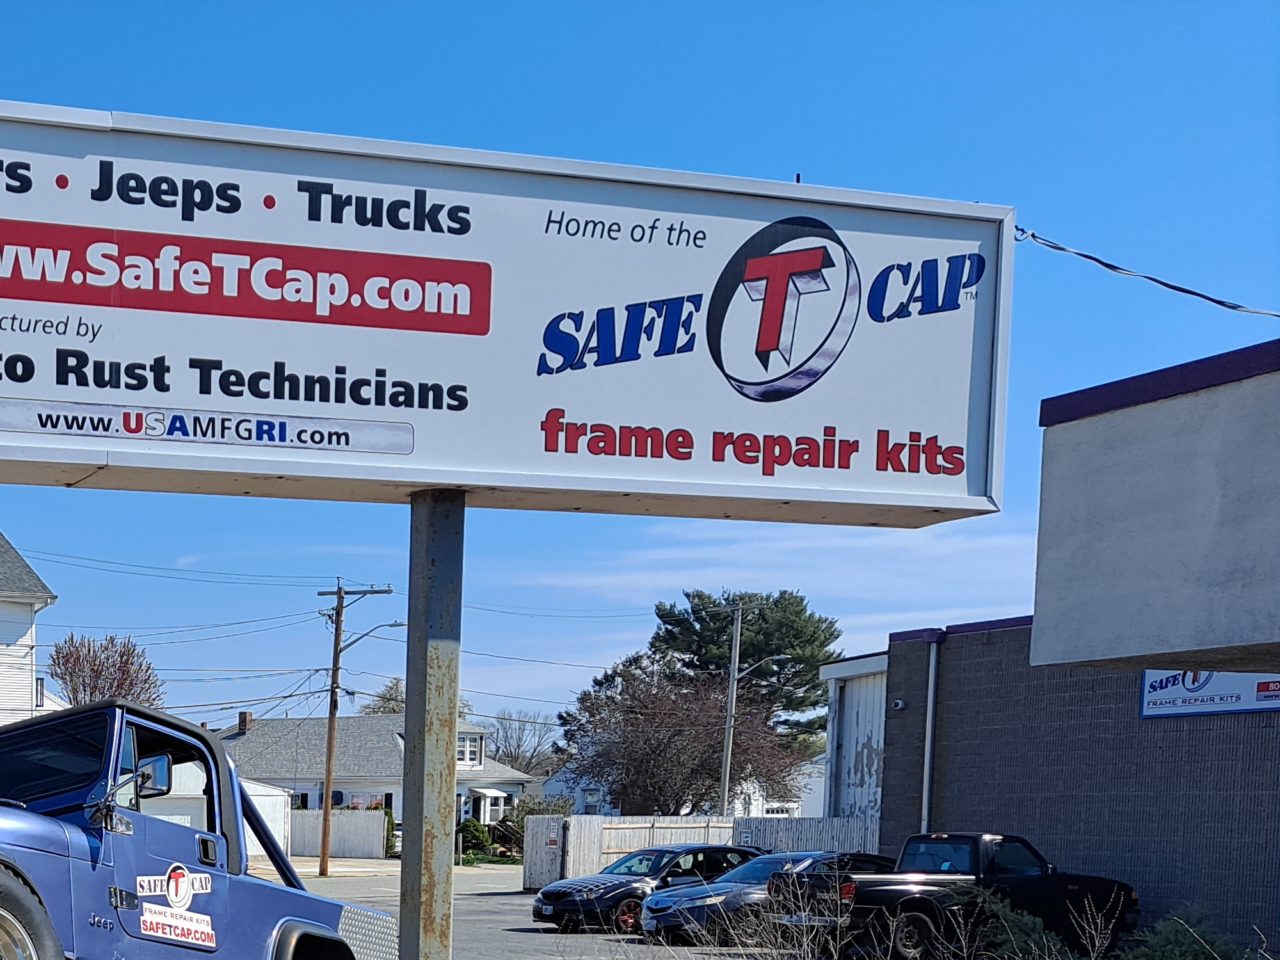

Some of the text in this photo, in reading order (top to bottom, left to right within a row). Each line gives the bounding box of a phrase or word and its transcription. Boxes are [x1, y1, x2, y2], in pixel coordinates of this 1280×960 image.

[90, 160, 241, 222] Jeeps
[297, 180, 472, 236] Trucks
[544, 210, 707, 249] Home of the
[963, 291, 979, 301] TM
[536, 245, 986, 376] SAFE T CAP
[76, 317, 103, 343] by
[55, 348, 170, 393] Rust
[188, 358, 469, 412] Technicians
[36, 410, 350, 447] www.USAMFGRI.com
[540, 408, 965, 477] frame repair kits
[1148, 673, 1181, 694] SAFE
[1269, 682, 1280, 690] 80
[1147, 699, 1177, 707] FRAME
[1181, 696, 1216, 705] REPAIR
[138, 871, 211, 897] SAFE T CAP
[88, 912, 114, 932] Jeep
[144, 907, 210, 926] FRAME REPAIR KITS
[142, 919, 214, 944] SAFETCAP.COM
